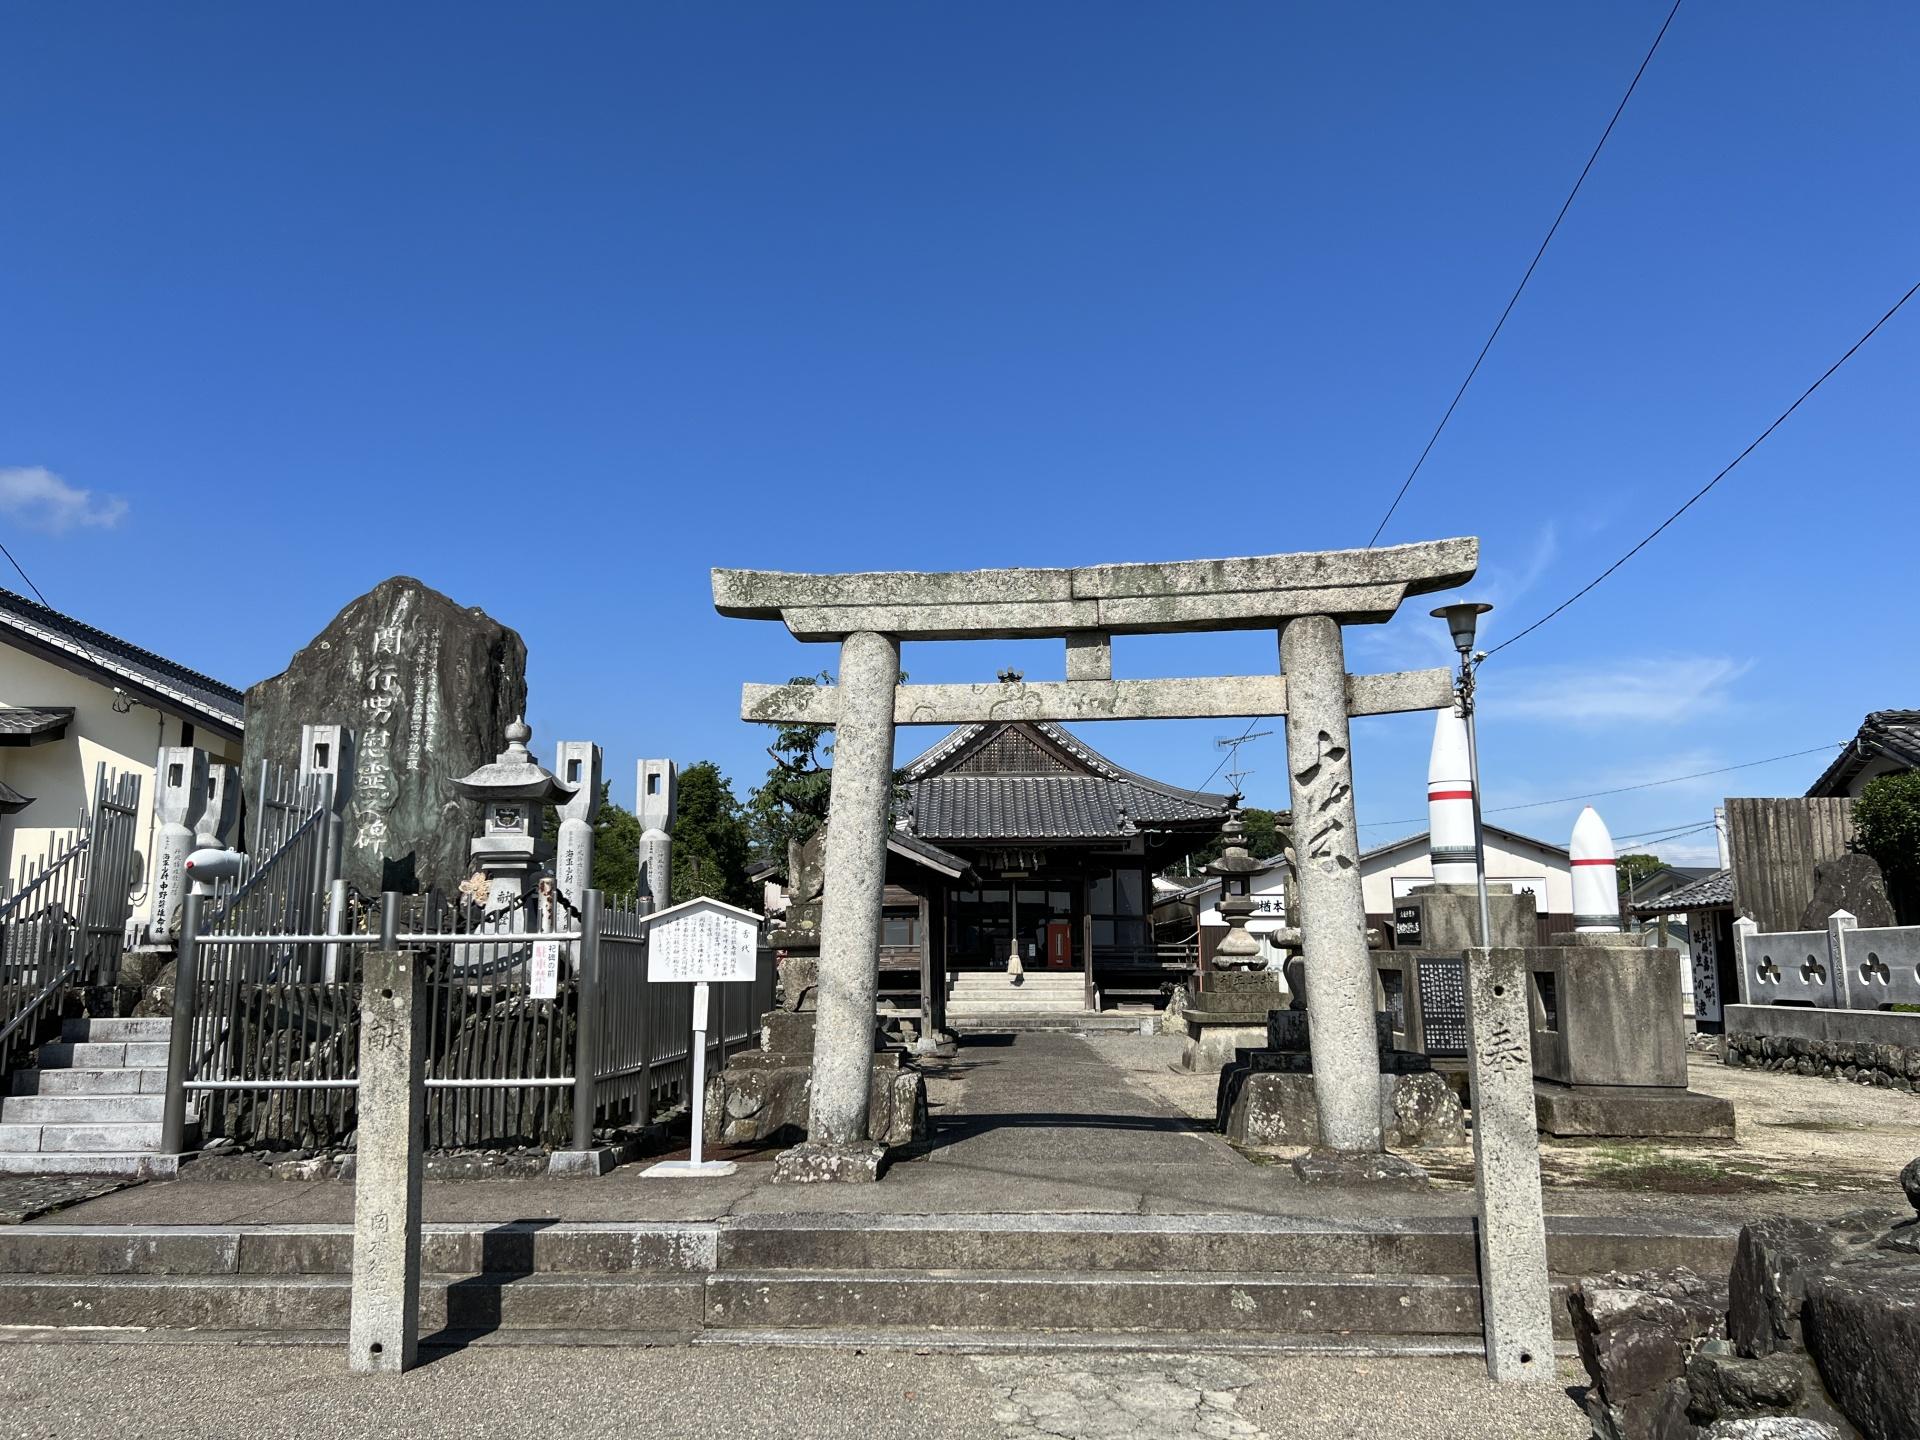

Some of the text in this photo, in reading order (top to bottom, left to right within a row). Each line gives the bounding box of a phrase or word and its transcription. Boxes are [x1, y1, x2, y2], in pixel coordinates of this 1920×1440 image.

[352, 626, 402, 854] 関行男慰霊之碑
[369, 1018, 404, 1052] 献
[1481, 1021, 1527, 1083] 奉
